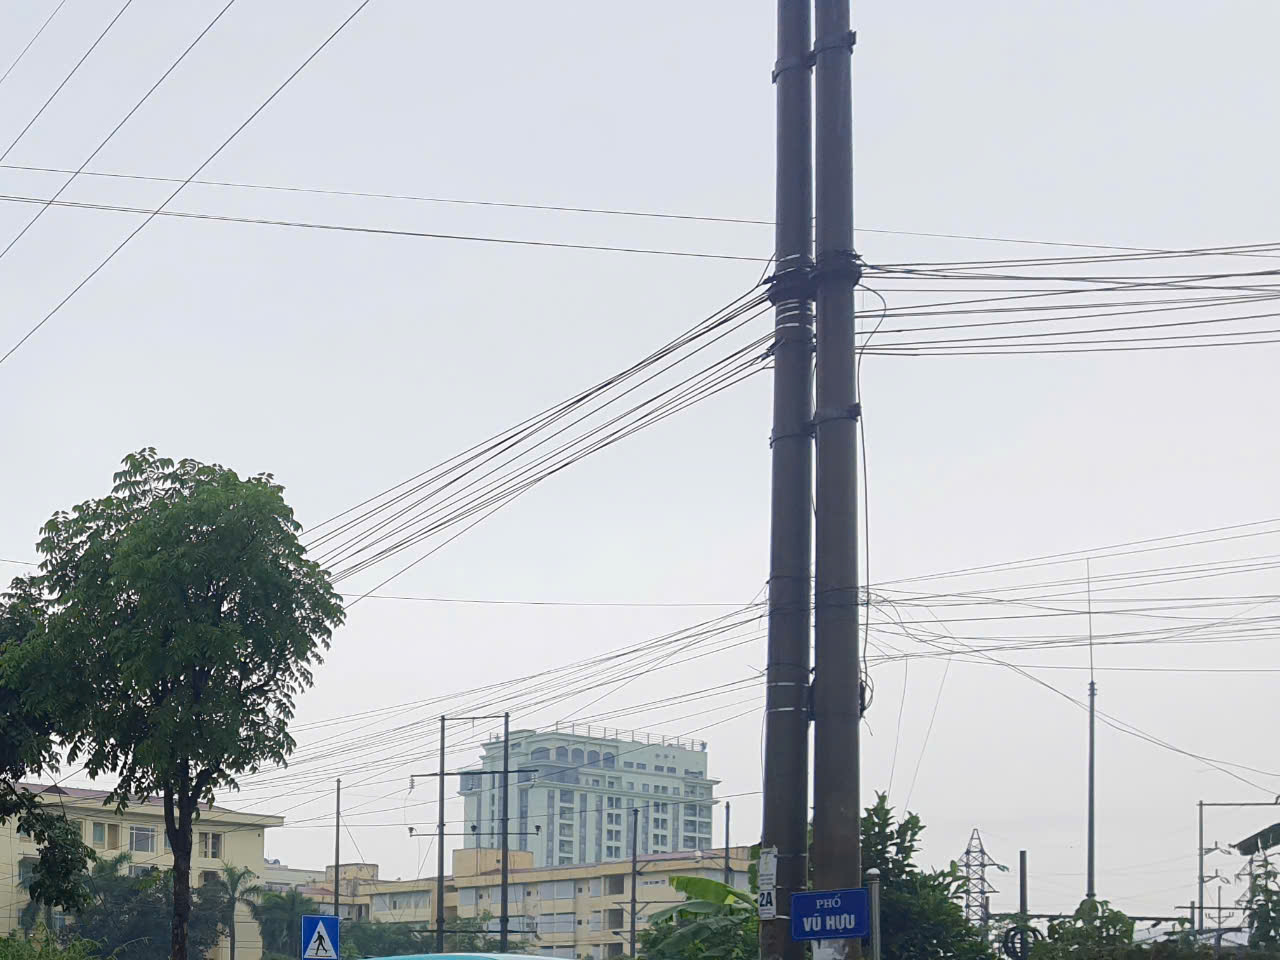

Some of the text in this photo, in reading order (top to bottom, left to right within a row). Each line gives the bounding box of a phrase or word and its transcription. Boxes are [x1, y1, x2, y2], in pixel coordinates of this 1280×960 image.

[760, 892, 773, 907] 2A
[816, 893, 841, 909] PHỐ
[803, 913, 821, 932] VŨ
